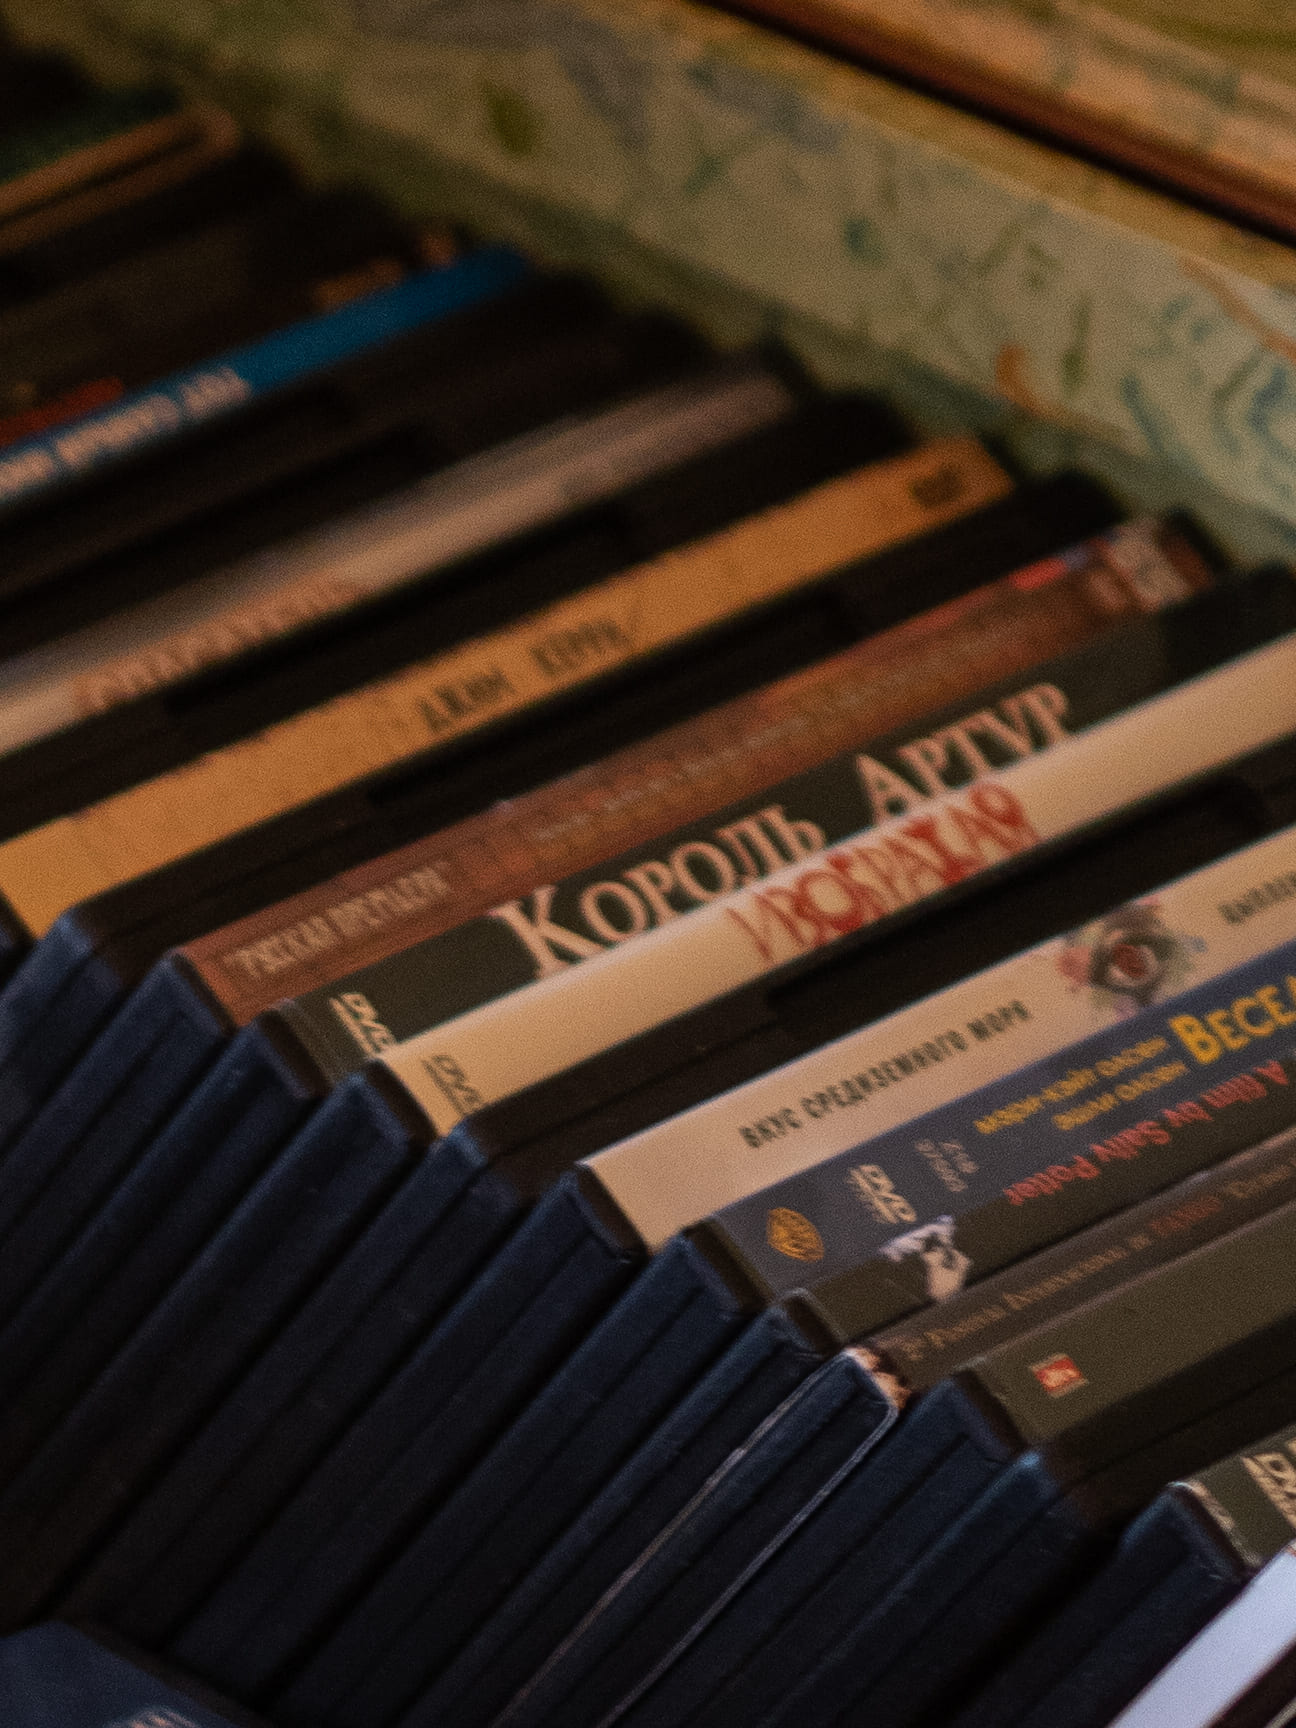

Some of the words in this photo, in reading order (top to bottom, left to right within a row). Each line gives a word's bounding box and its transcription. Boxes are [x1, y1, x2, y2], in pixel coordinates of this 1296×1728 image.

[1252, 1060, 1290, 1085] A
[1201, 1074, 1267, 1109] film
[739, 1108, 800, 1148] ВКУС
[1162, 1101, 1212, 1127] by
